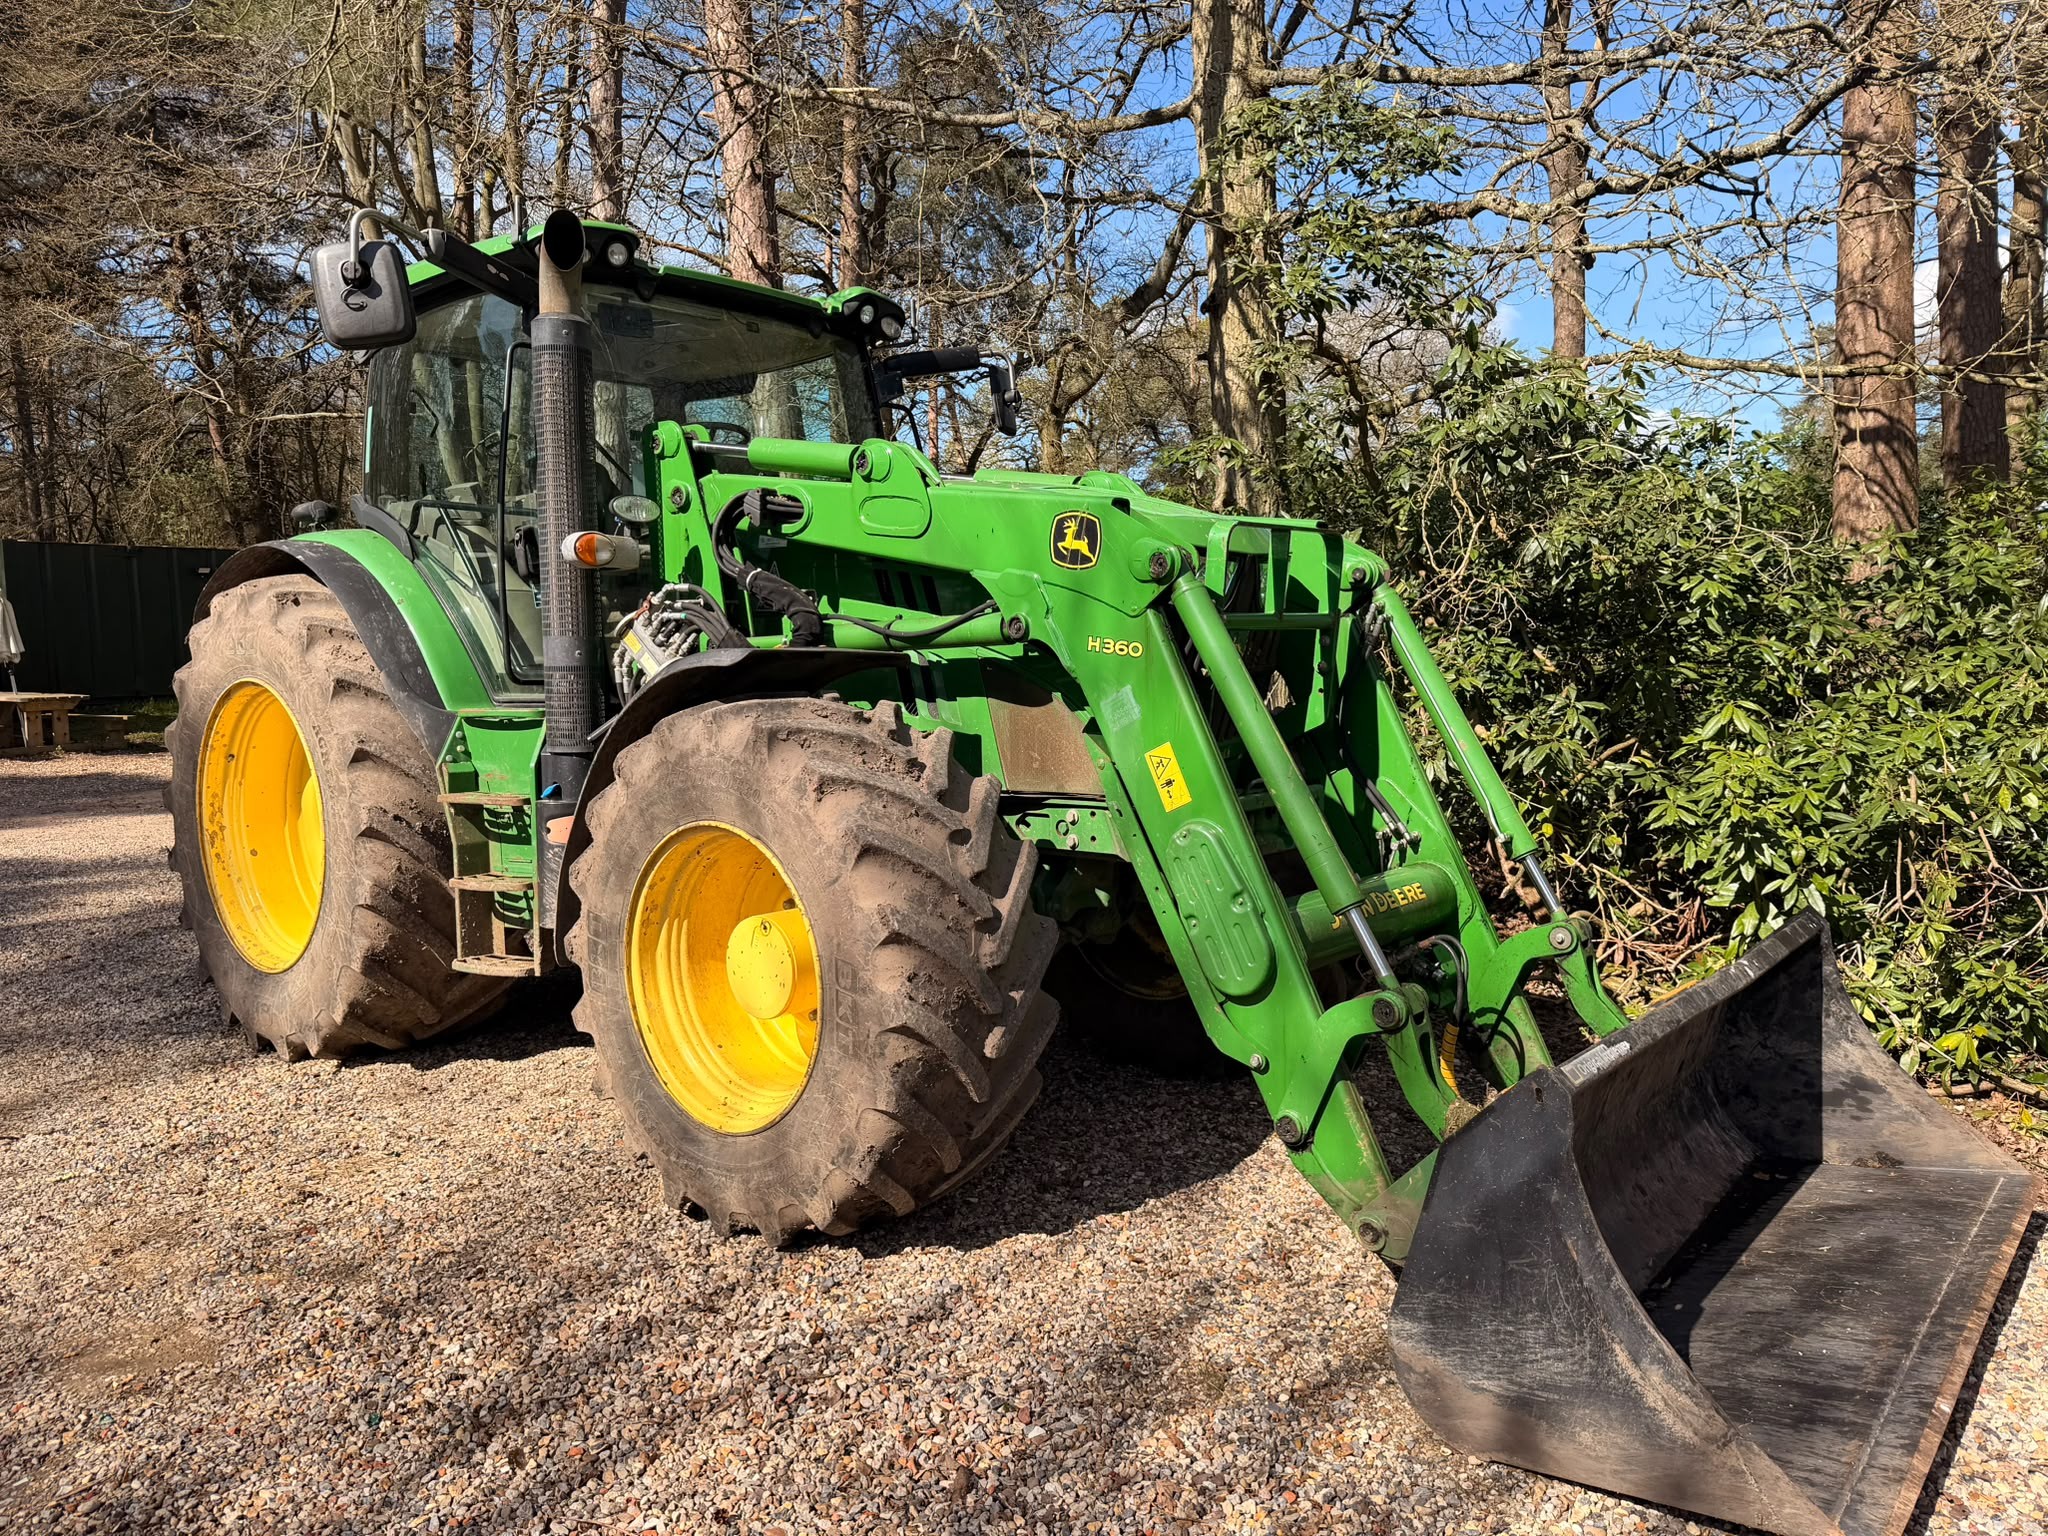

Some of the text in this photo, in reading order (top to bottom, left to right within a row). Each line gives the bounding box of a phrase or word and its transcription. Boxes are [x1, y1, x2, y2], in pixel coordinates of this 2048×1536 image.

[1087, 635, 1144, 658] H360
[1331, 882, 1427, 930] JN DEERE
[834, 954, 860, 1061] BKT
